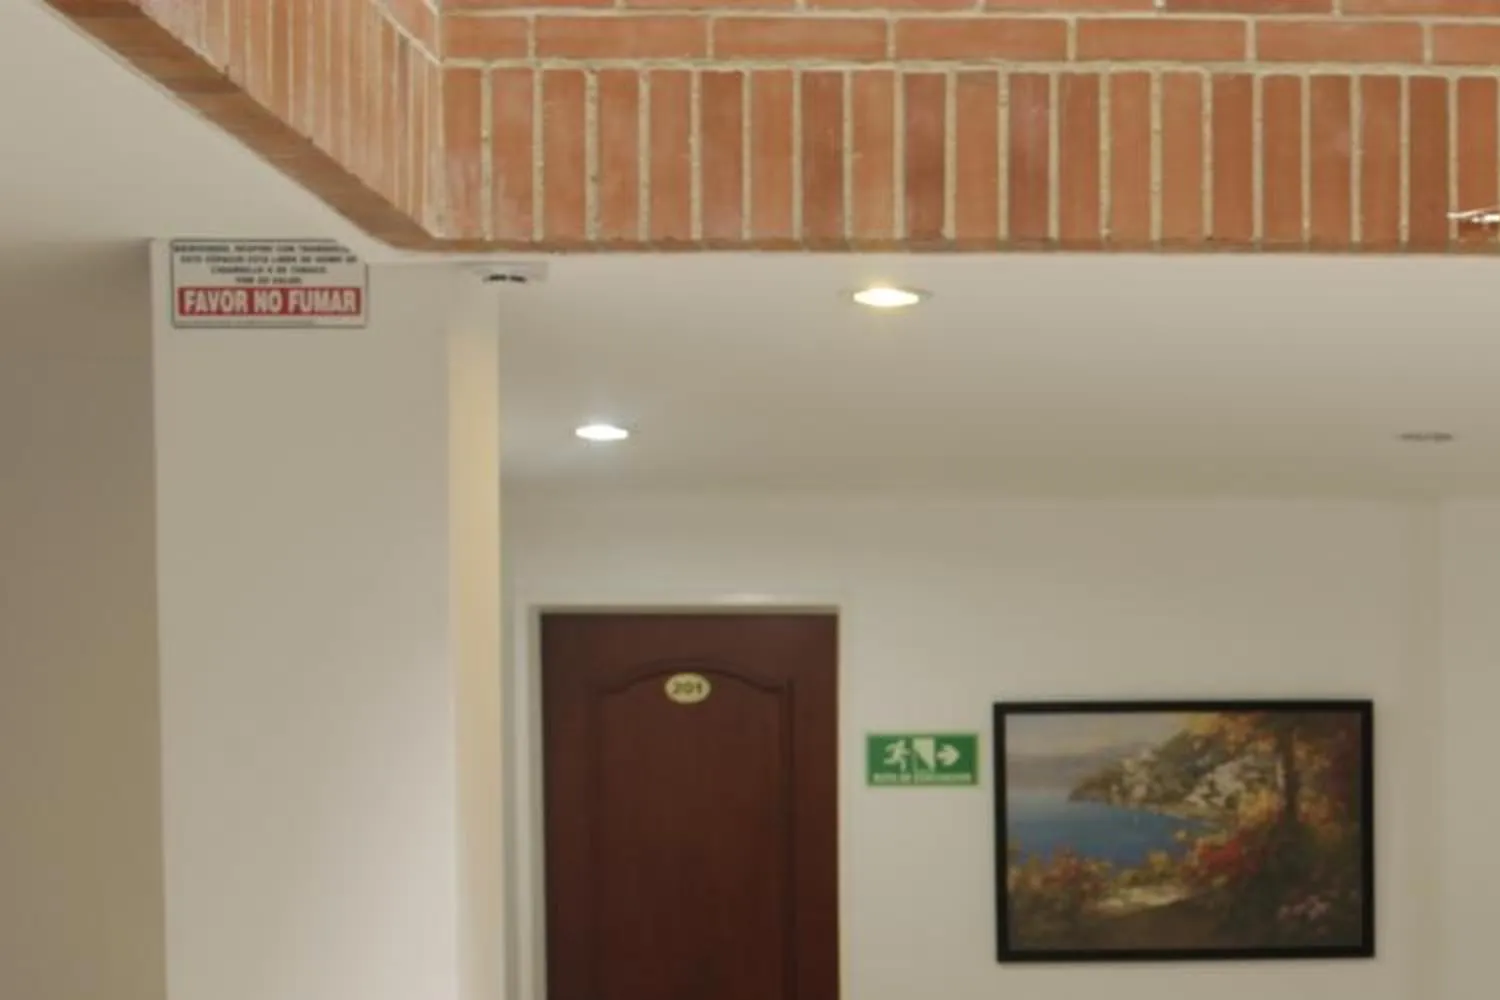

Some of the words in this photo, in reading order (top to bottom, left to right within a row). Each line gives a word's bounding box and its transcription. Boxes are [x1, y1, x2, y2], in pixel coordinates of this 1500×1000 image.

[186, 290, 248, 313] FAVOR
[253, 289, 284, 313] NO
[288, 290, 357, 313] FUMAR
[673, 680, 703, 696] 201
